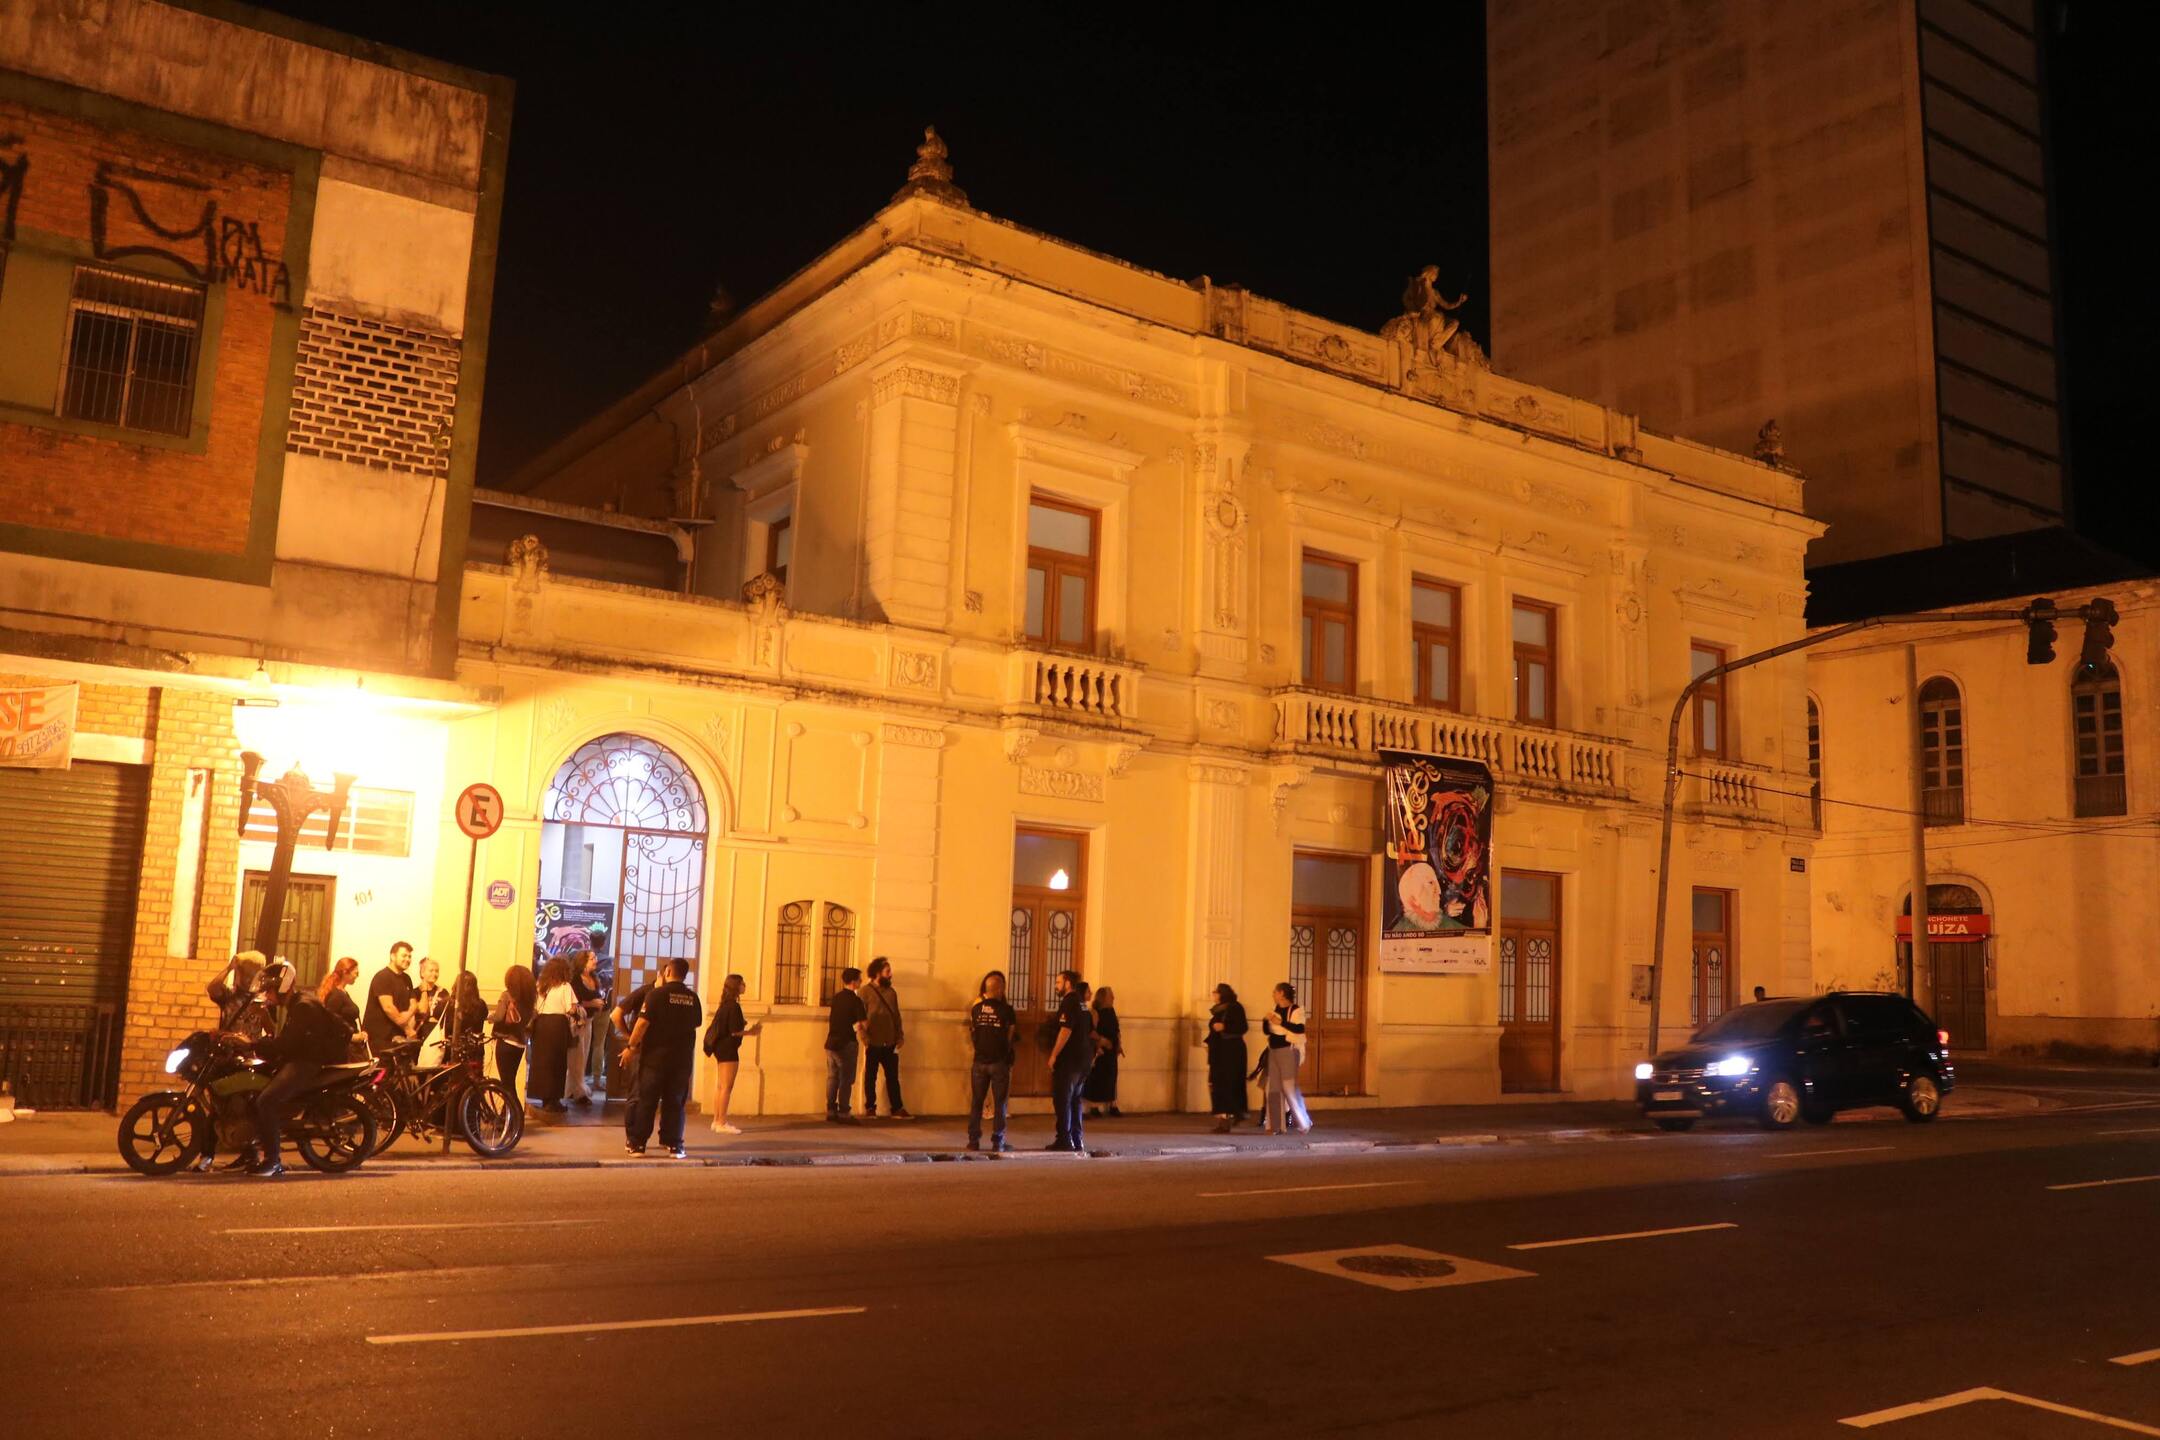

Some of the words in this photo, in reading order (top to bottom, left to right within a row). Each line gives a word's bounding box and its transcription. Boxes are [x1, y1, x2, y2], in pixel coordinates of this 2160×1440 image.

[470, 795, 490, 827] E
[354, 890, 373, 907] 101
[493, 887, 509, 897] ADT
[1927, 922, 1969, 935] UÍZA
